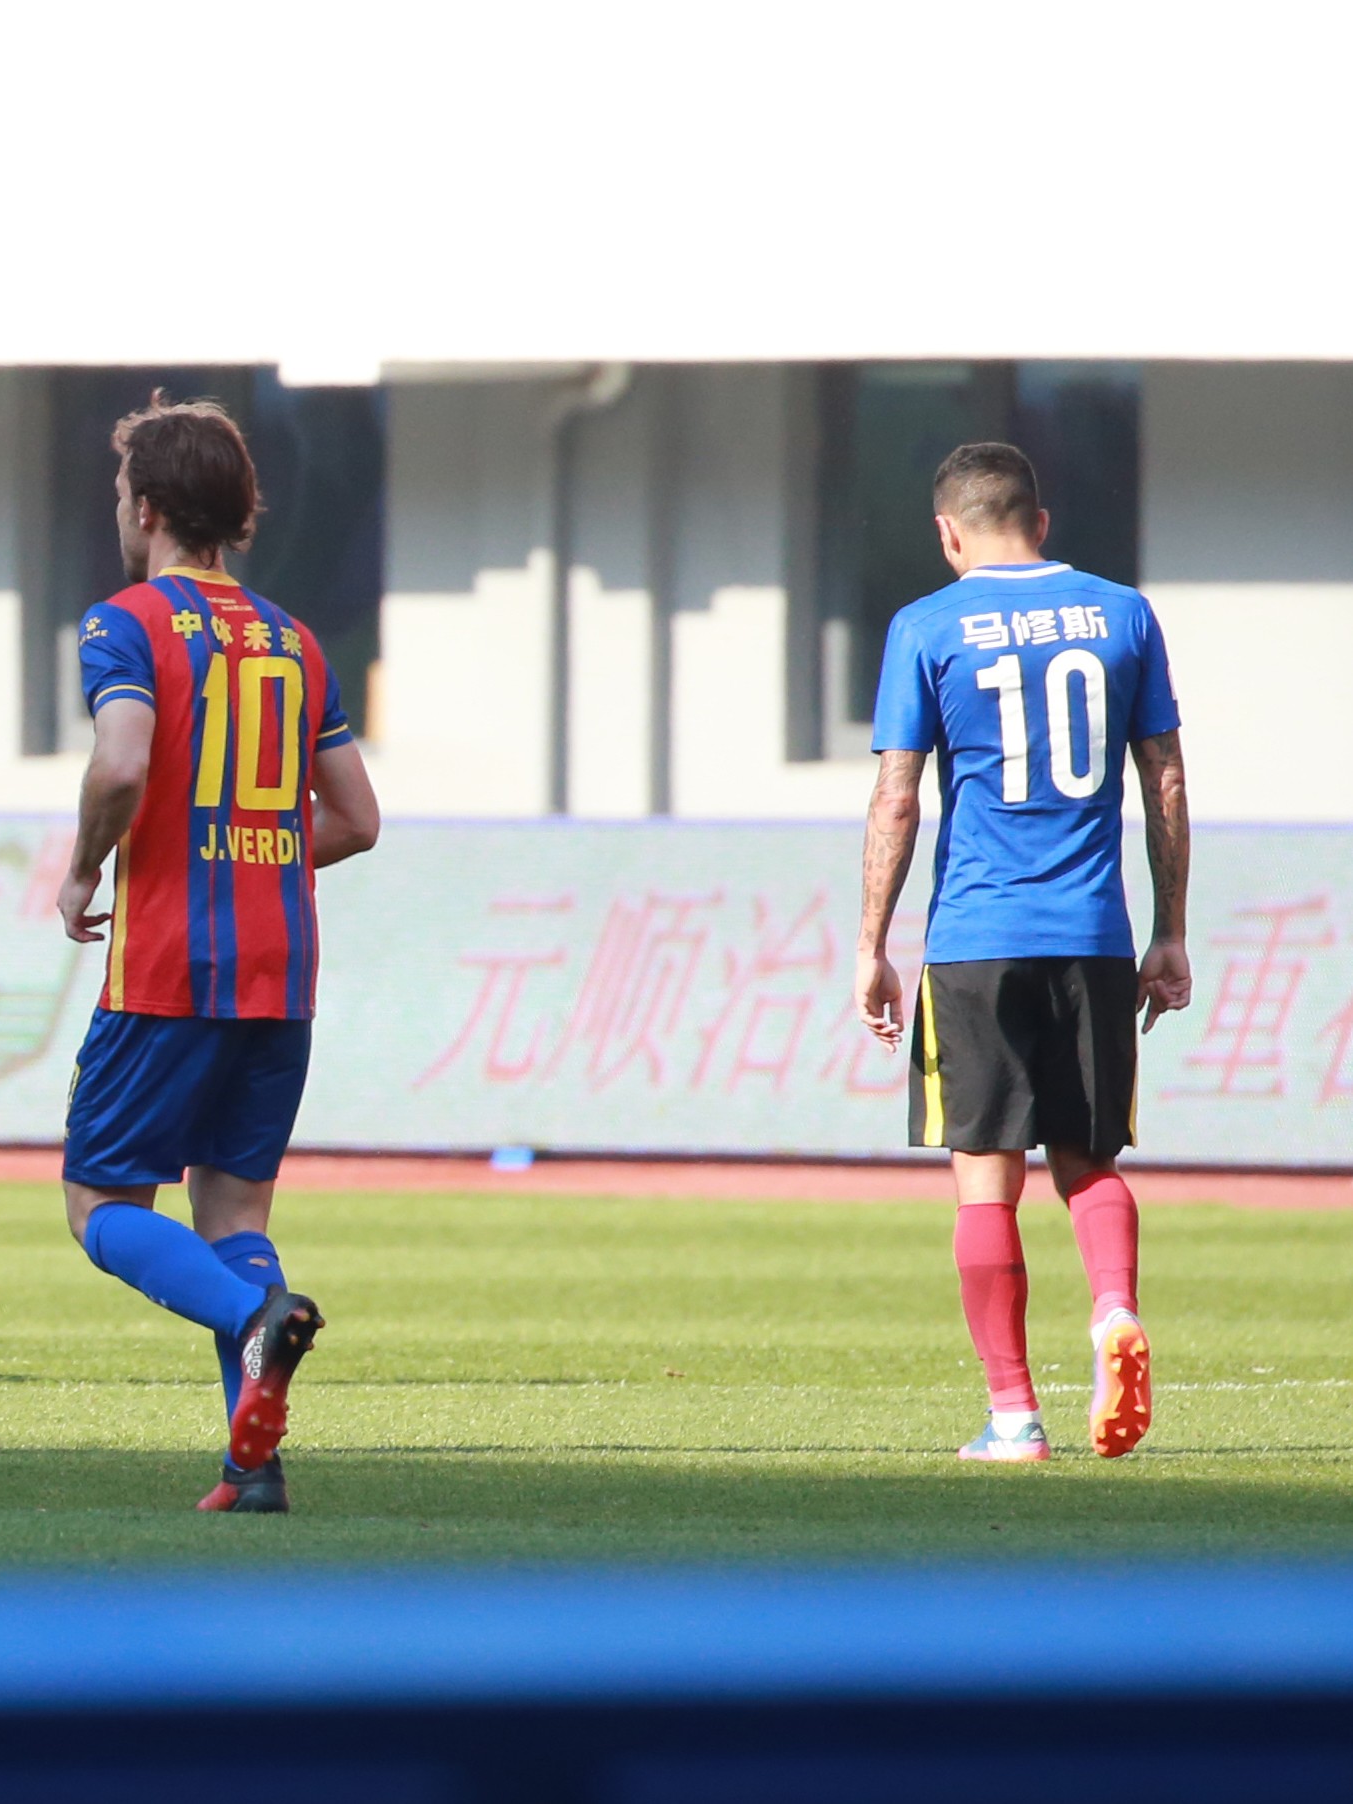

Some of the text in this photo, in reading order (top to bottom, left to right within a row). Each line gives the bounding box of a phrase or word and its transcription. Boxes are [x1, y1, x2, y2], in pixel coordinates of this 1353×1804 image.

[960, 605, 1109, 650] 马修斯
[194, 652, 304, 811] 10
[976, 648, 1108, 804] 10
